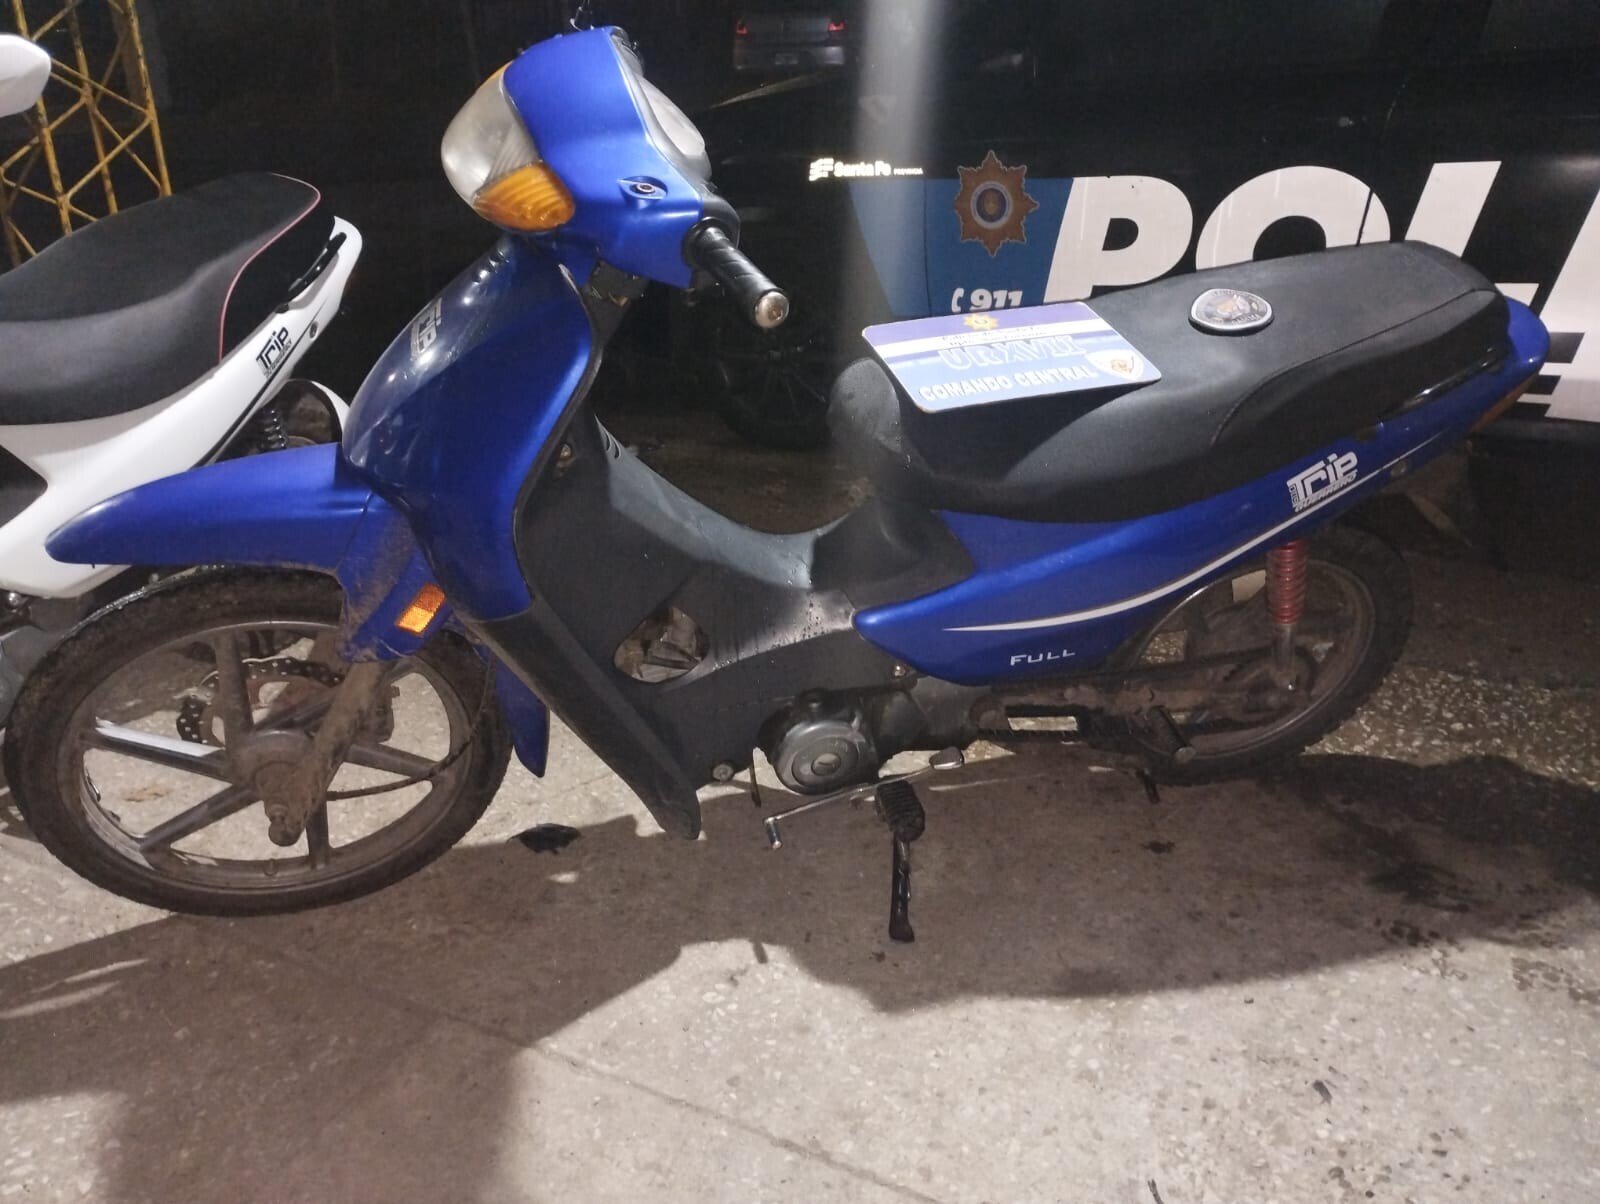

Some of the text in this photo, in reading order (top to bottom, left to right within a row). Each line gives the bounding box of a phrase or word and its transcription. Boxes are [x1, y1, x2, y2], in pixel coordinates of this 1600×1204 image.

[834, 160, 892, 177] Santa Fe
[969, 288, 1023, 311] 911
[919, 365, 1098, 401] COMANDO CENTRAL
[1010, 649, 1076, 666] FULL
